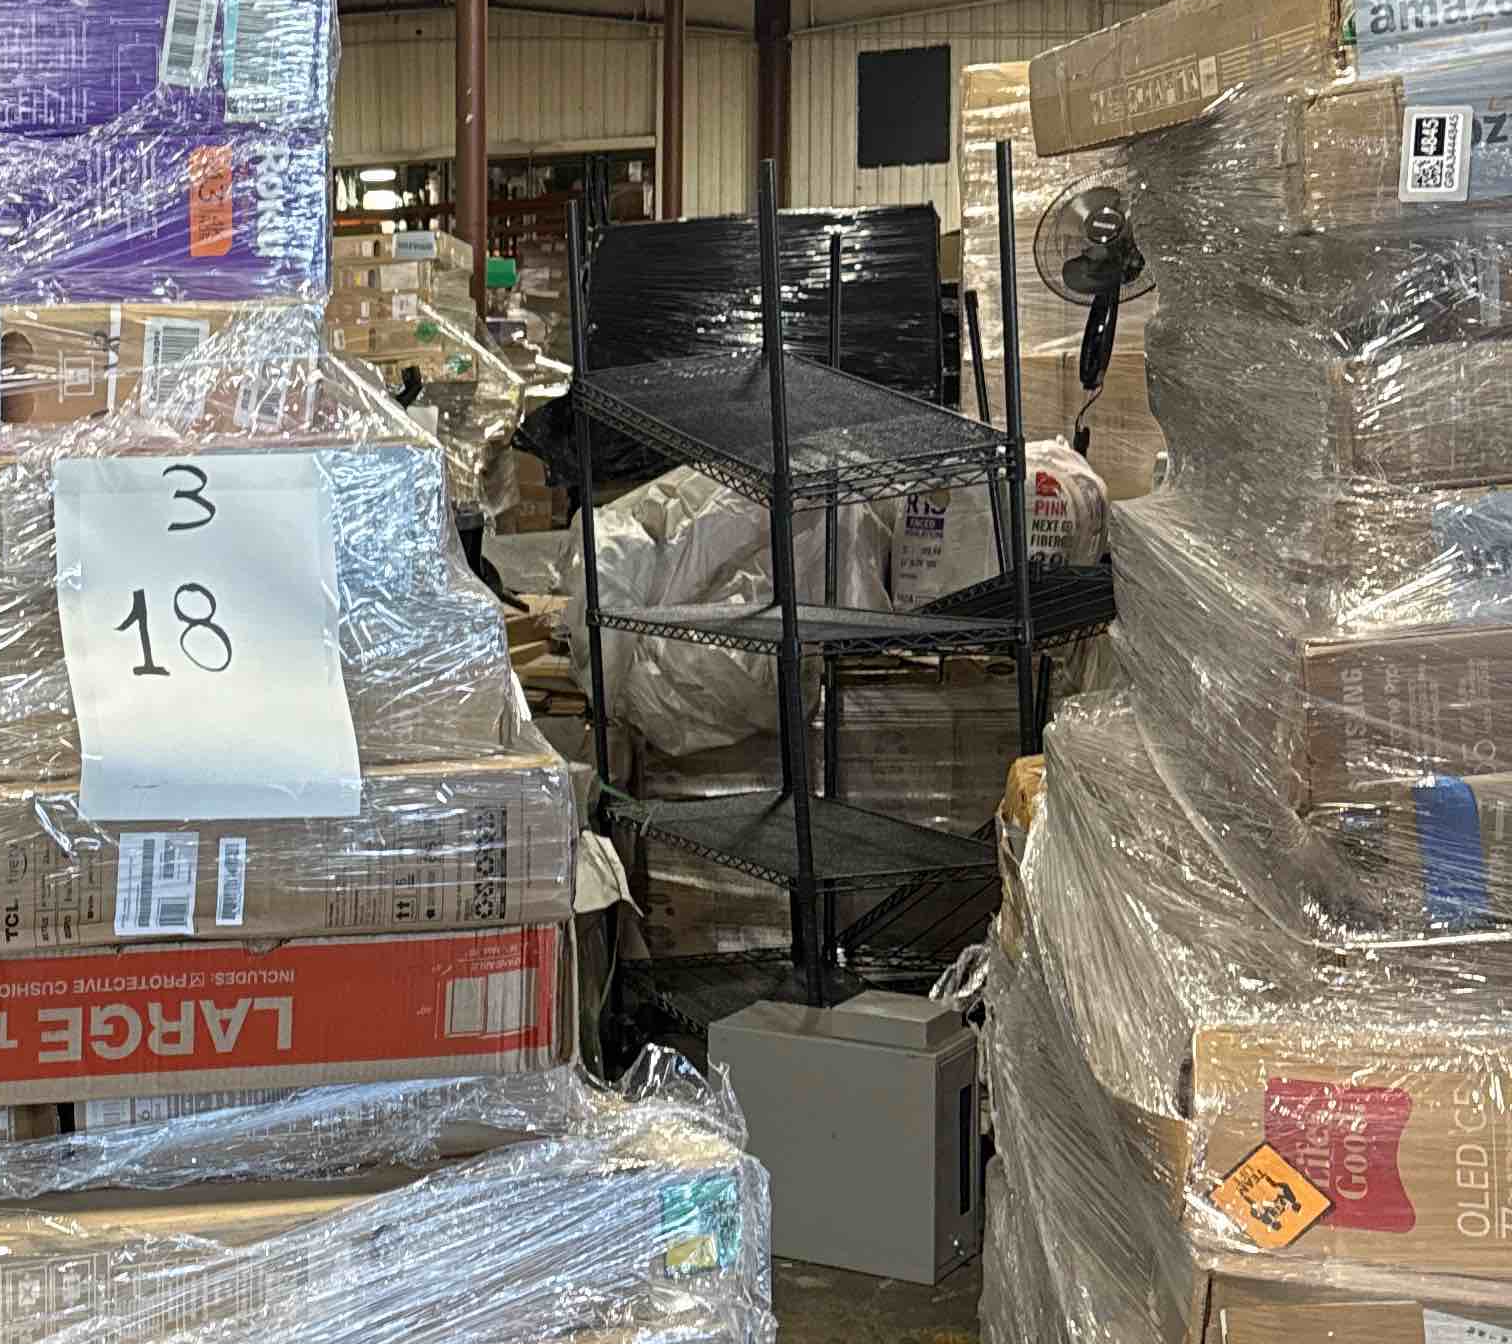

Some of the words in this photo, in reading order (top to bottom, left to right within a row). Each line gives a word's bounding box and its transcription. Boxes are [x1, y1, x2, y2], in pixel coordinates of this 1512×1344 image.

[1420, 119, 1440, 155] 4845
[161, 466, 217, 532] 3
[1034, 499, 1068, 515] PINK
[1032, 519, 1058, 532] NEXT
[114, 582, 234, 678] 18
[5, 899, 20, 943] TCL
[73, 971, 189, 994] PROTECTIVE
[209, 969, 295, 987] INCLUDES:
[38, 995, 294, 1064] LARGE
[1456, 1144, 1490, 1237] OLED
